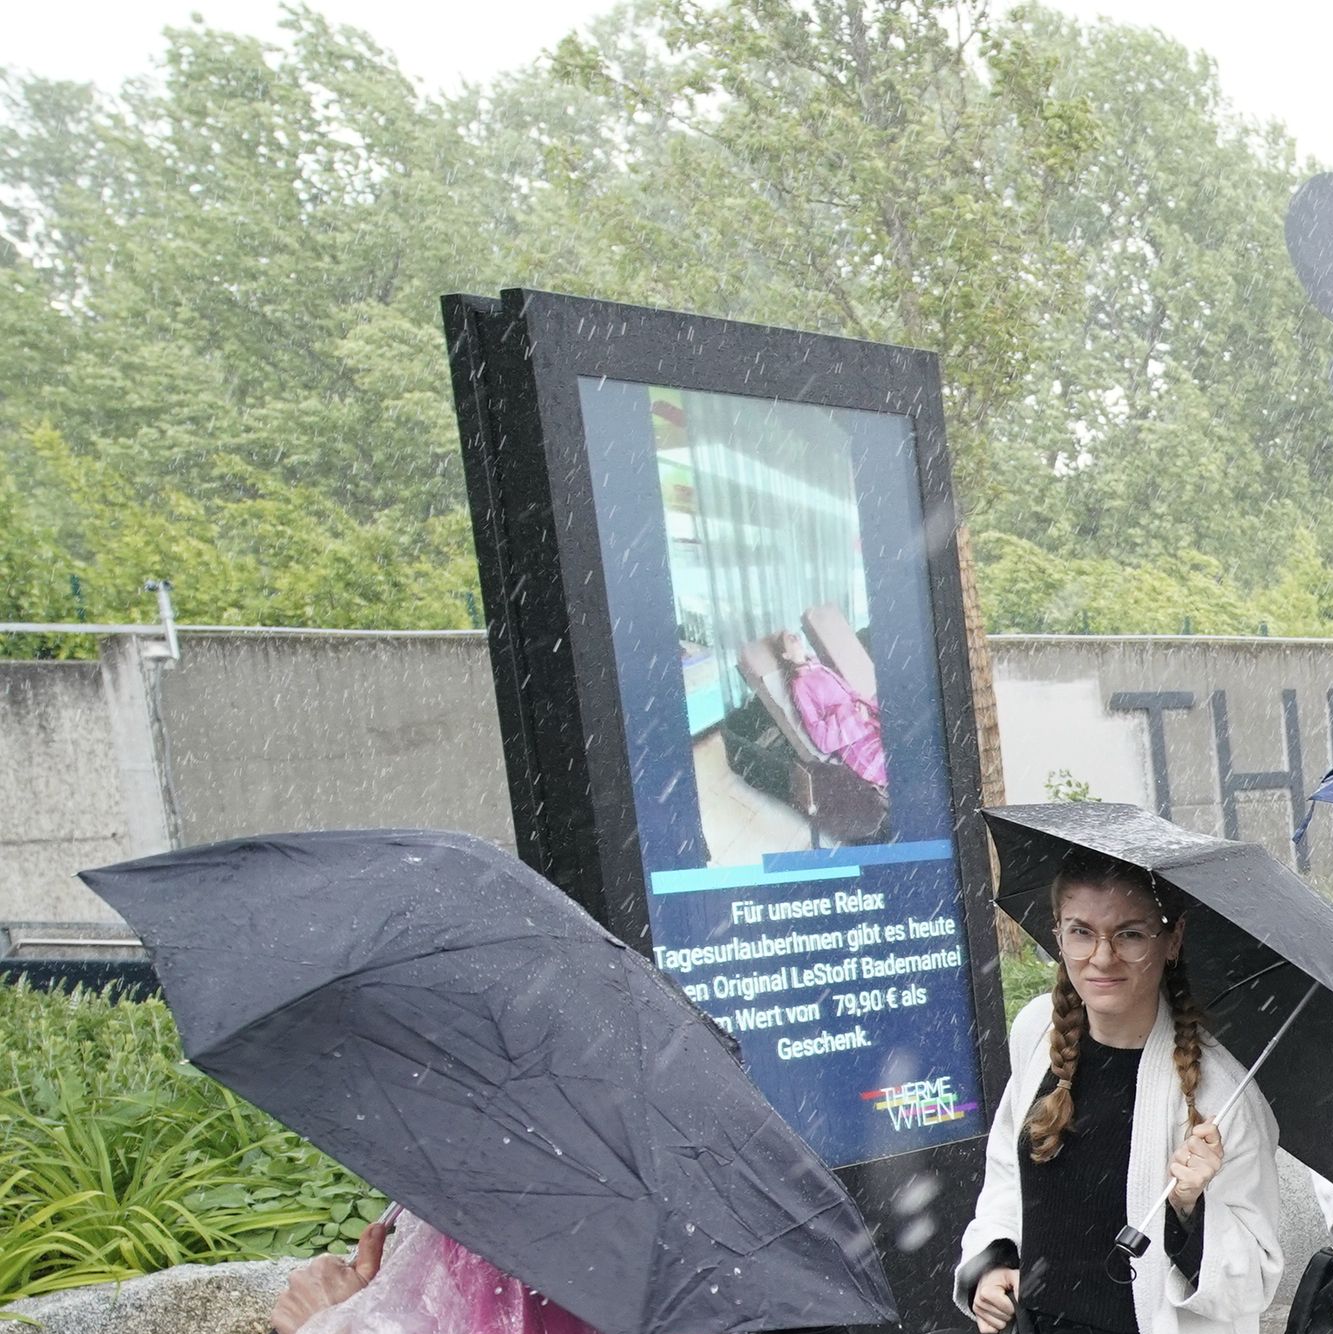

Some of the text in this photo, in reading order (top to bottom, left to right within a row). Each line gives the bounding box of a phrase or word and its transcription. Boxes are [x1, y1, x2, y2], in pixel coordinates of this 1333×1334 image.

[731, 889, 885, 925] Für unsere Relax
[847, 925, 882, 952] gibt
[885, 922, 906, 941] es
[908, 917, 956, 940] heute
[713, 969, 788, 1001] Original
[792, 961, 857, 990] LeStoff
[862, 945, 962, 980] Bademantel
[736, 1005, 783, 1032] Wert
[787, 1003, 820, 1024] von
[833, 993, 883, 1019] 79,90
[887, 991, 899, 1010] €
[901, 985, 927, 1006] als
[777, 1027, 872, 1060] Geschenk.
[881, 1076, 952, 1109] THERME
[888, 1097, 956, 1132] WIEN
